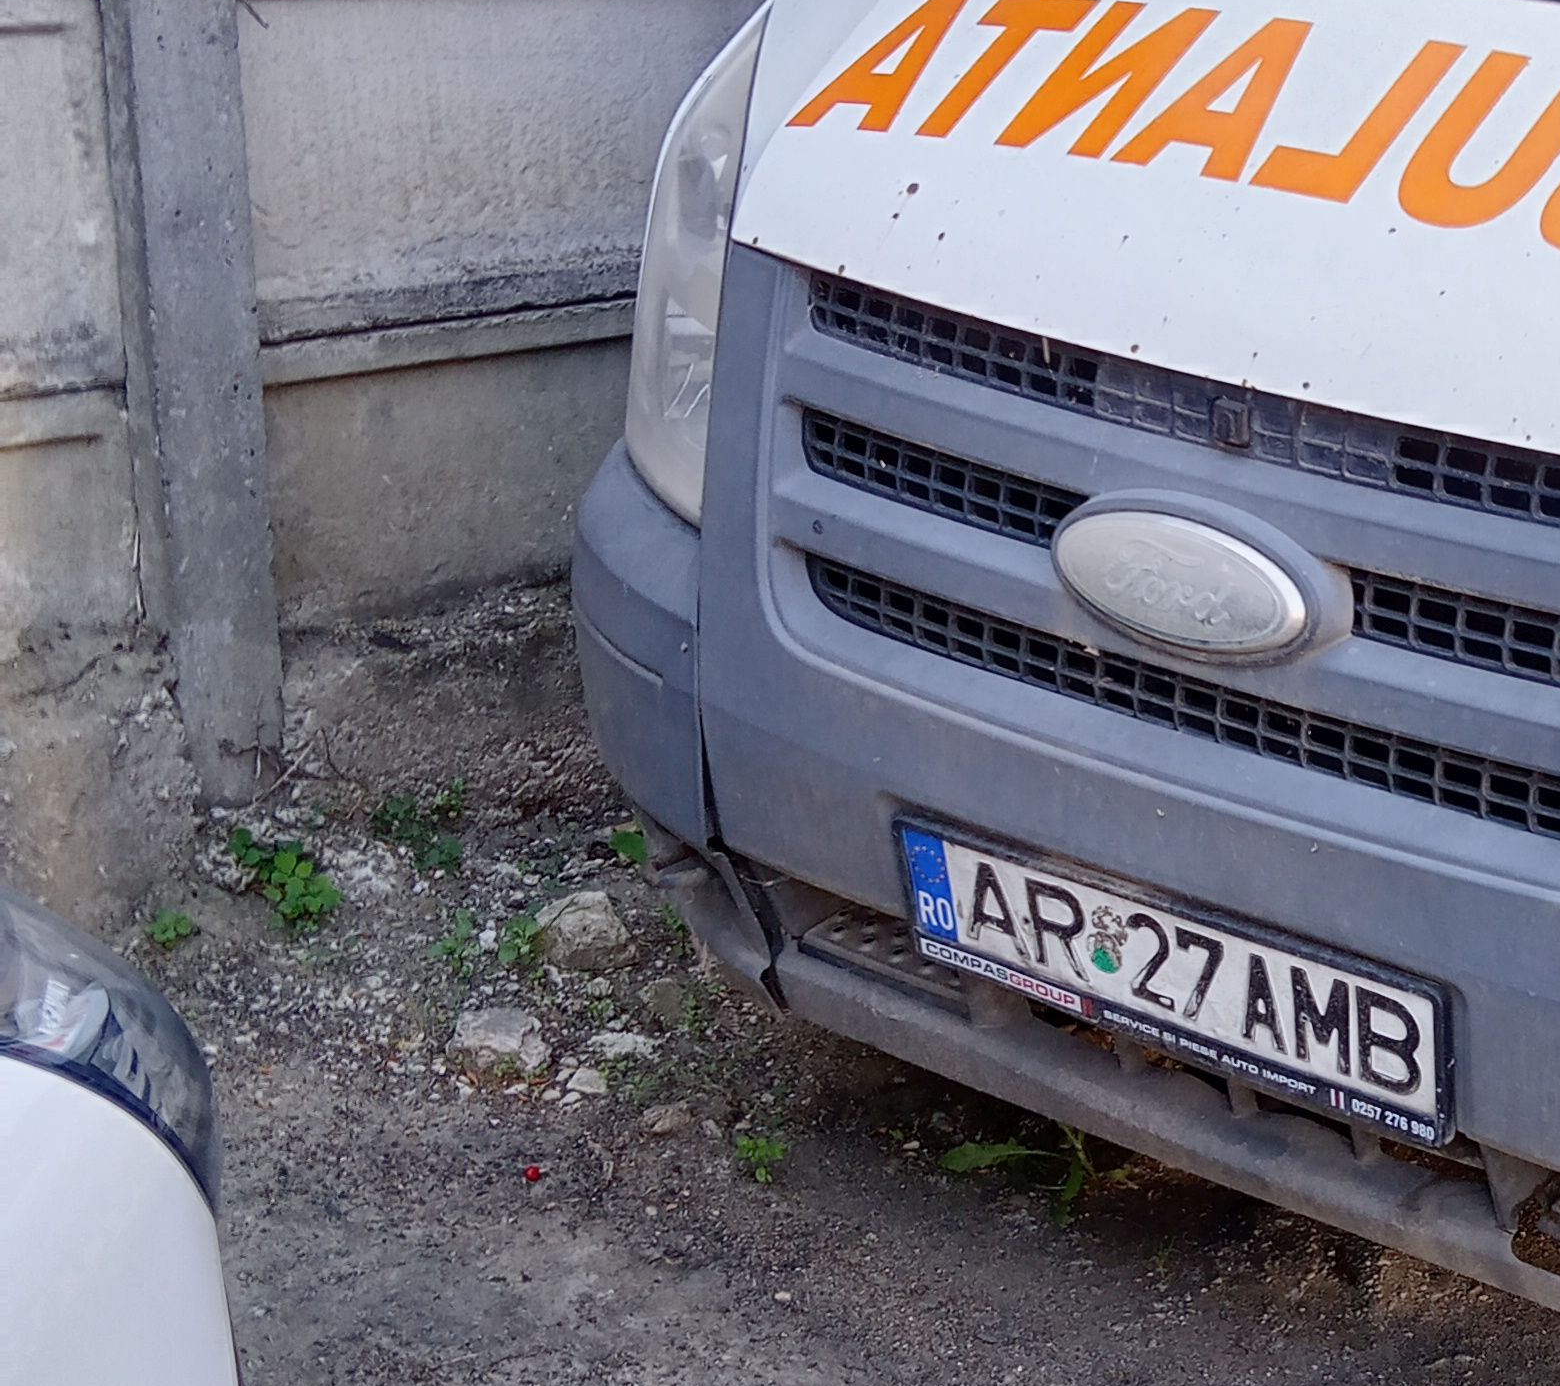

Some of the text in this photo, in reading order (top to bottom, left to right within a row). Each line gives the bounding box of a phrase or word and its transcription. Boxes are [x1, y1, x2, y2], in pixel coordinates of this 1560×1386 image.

[1104, 539, 1233, 627] Ford
[918, 889, 955, 932] RO
[1103, 1009, 1317, 1096] SERVICE SI PIESE AUTO IMPORT
[1351, 1098, 1435, 1141] 0257 276 980
